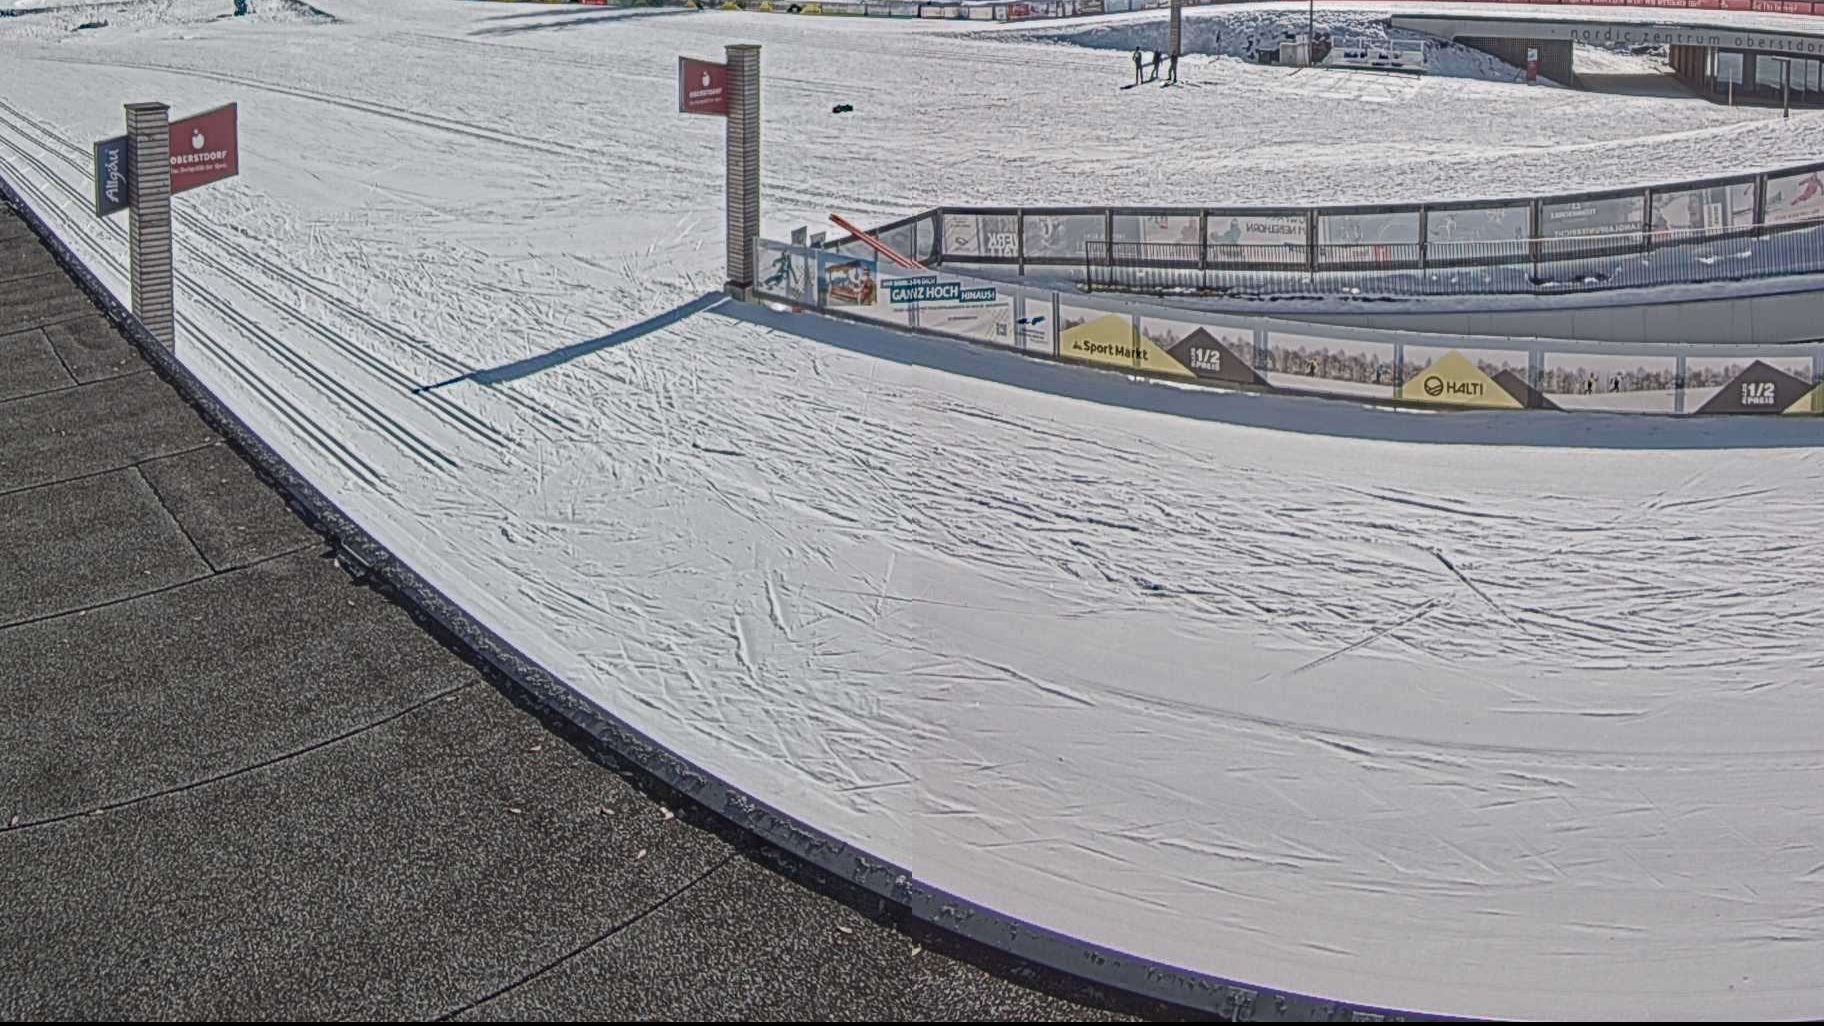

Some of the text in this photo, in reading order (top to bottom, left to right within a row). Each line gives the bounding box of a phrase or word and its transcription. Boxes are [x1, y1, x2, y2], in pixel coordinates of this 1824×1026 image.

[1571, 27, 1631, 42] nordic
[1642, 32, 1720, 45] zentrum
[170, 150, 227, 165] OBERSTDORF
[105, 148, 127, 203] Allgäu
[926, 286, 959, 297] HOCH
[1083, 340, 1149, 361] Sport Markt
[1196, 348, 1220, 363] 1/2
[1446, 381, 1484, 395] HALTI
[1748, 382, 1775, 397] 1/2
